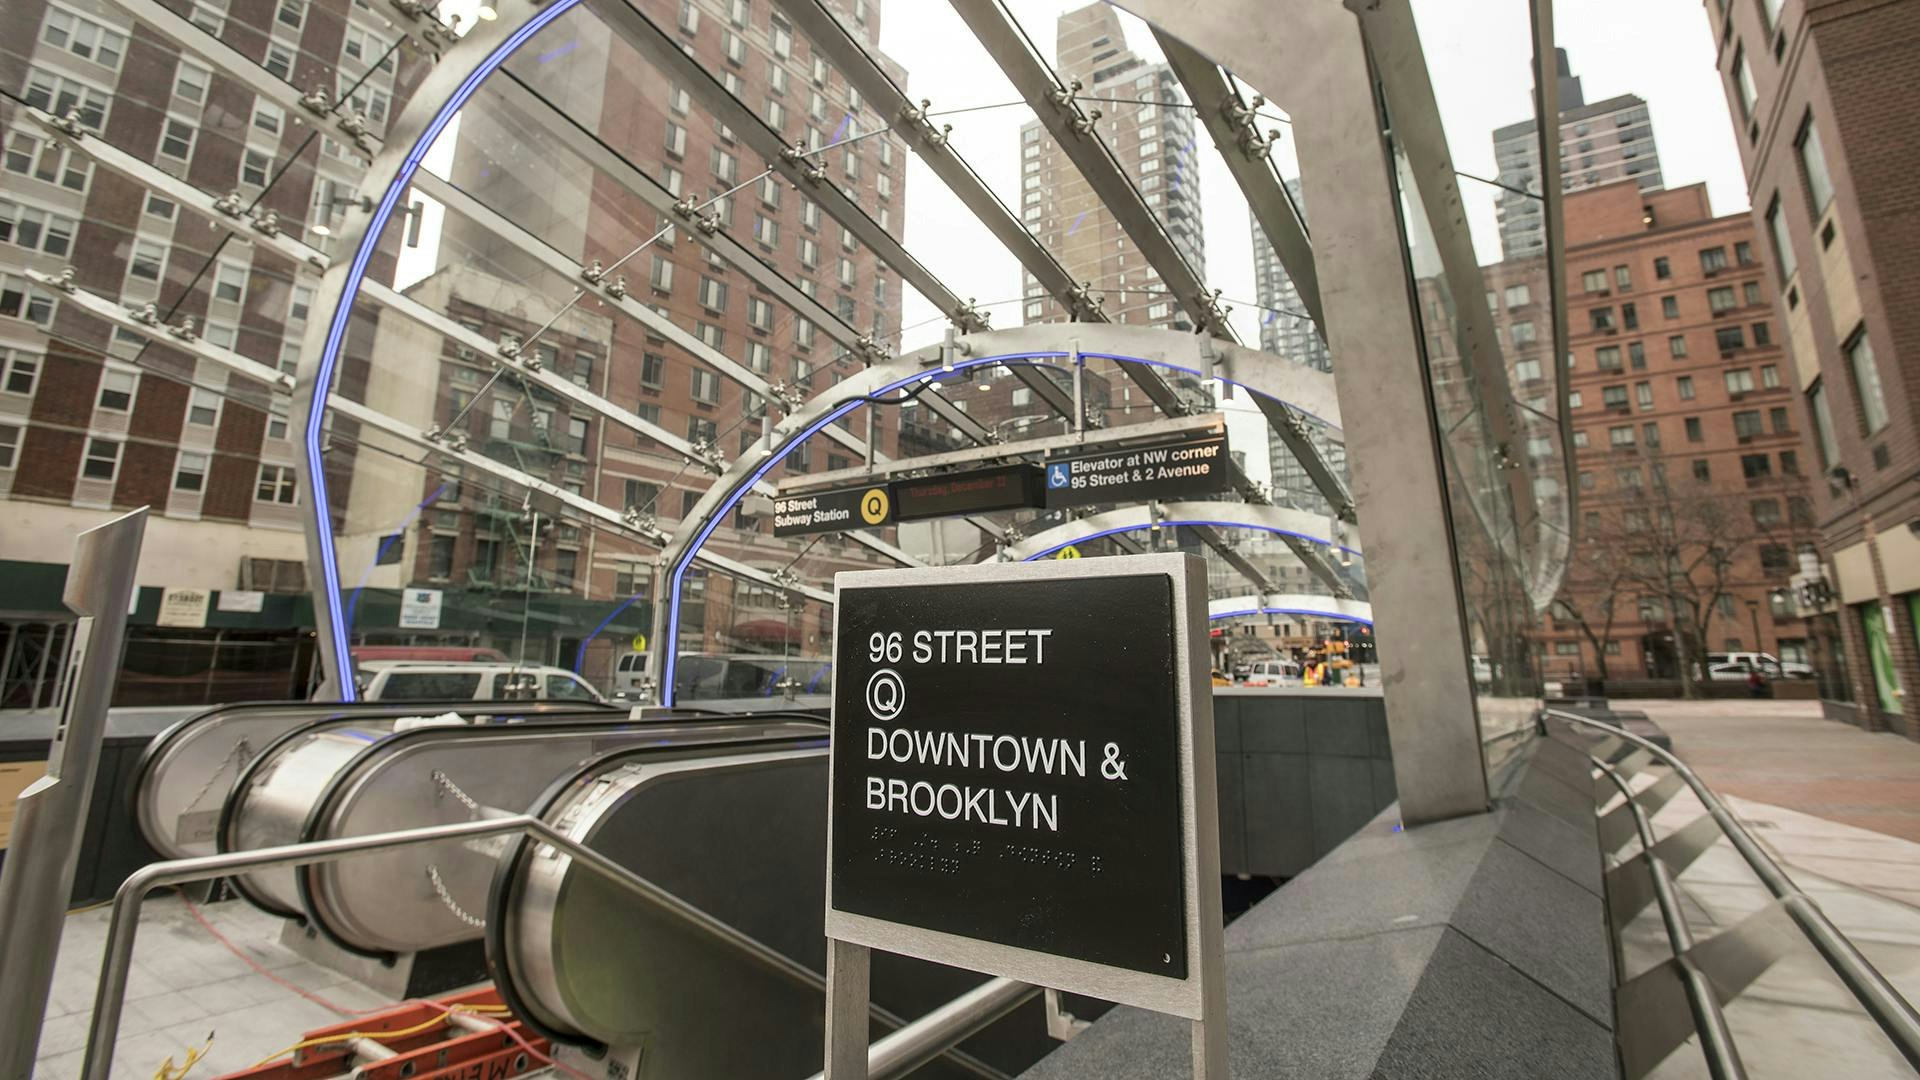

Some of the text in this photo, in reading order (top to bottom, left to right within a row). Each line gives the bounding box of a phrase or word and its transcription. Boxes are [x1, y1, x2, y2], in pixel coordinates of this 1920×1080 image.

[1071, 445, 1219, 474] Elevator at NW corner
[1071, 463, 1210, 489] 95 Street & 2 Avenue
[774, 497, 817, 514] 96 Street
[774, 508, 849, 527] Subway Station
[869, 629, 1053, 664] 96 STREET
[867, 727, 1128, 780] DOWNTOWN &
[866, 776, 1058, 832] BROOKLYN
